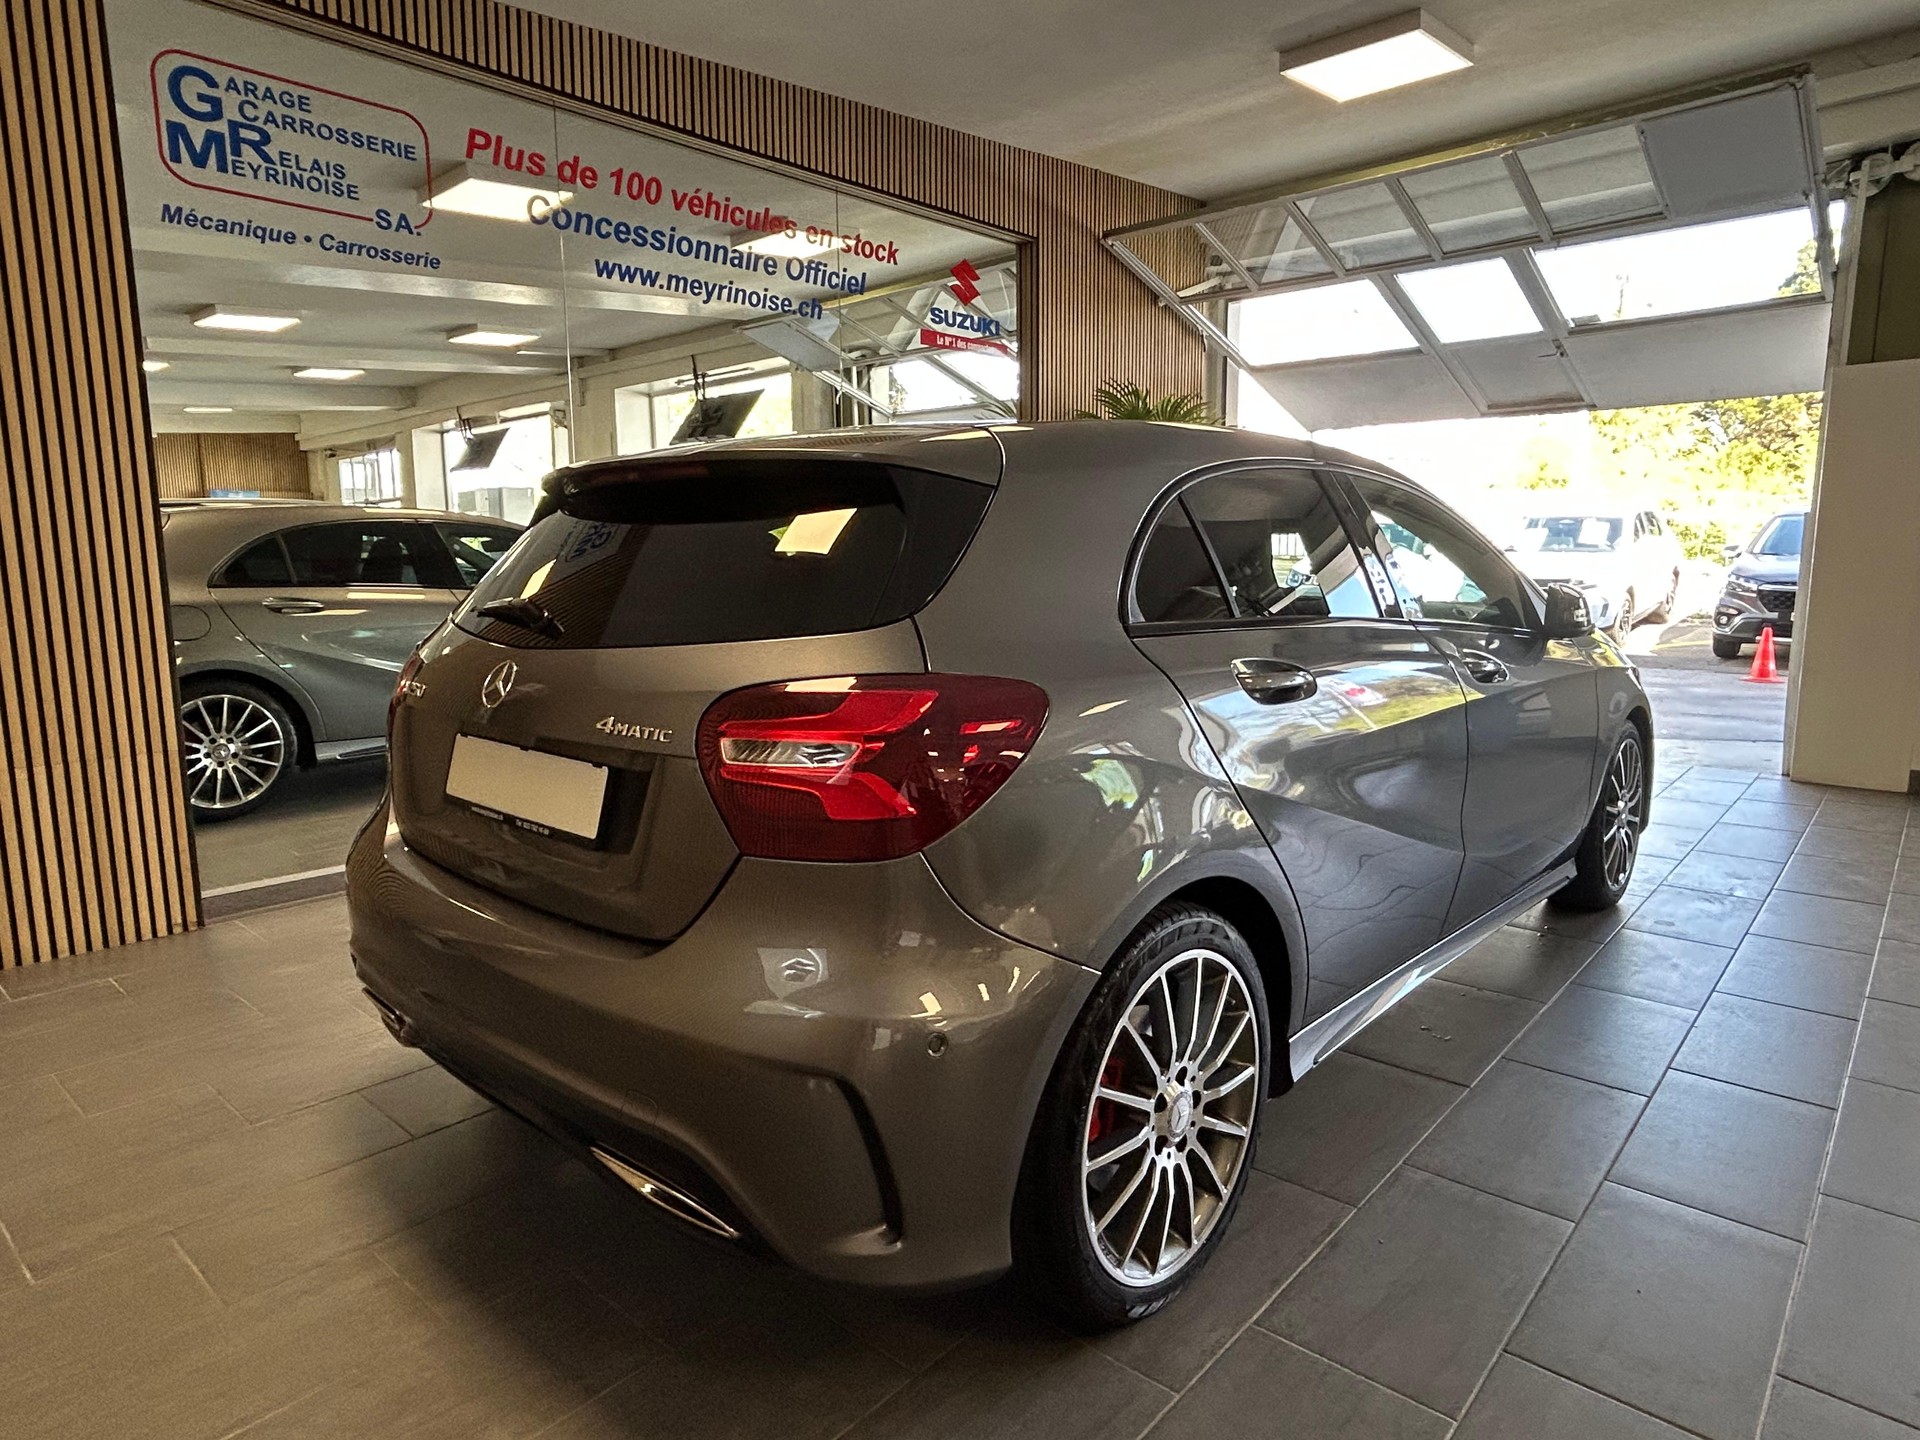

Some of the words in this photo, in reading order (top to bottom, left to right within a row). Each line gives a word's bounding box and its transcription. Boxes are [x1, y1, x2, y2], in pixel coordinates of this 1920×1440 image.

[168, 65, 312, 122] GARAGE
[166, 120, 360, 200] MEYRINOISE
[238, 100, 417, 161] CARROSSERIE
[465, 128, 546, 176] Plus
[558, 155, 598, 189] de
[610, 167, 662, 205] 100
[672, 188, 797, 239] véhicules
[806, 225, 832, 248] en
[841, 234, 899, 265] stock
[161, 203, 297, 245] Mécanique
[319, 233, 441, 270] Carrosserie
[527, 195, 777, 275] Concessionnaire
[786, 257, 866, 295] Officiel
[595, 259, 823, 320] www.meyrinoise.ch
[930, 307, 1000, 336] SUZUKI
[596, 716, 672, 742] 4MATIC
